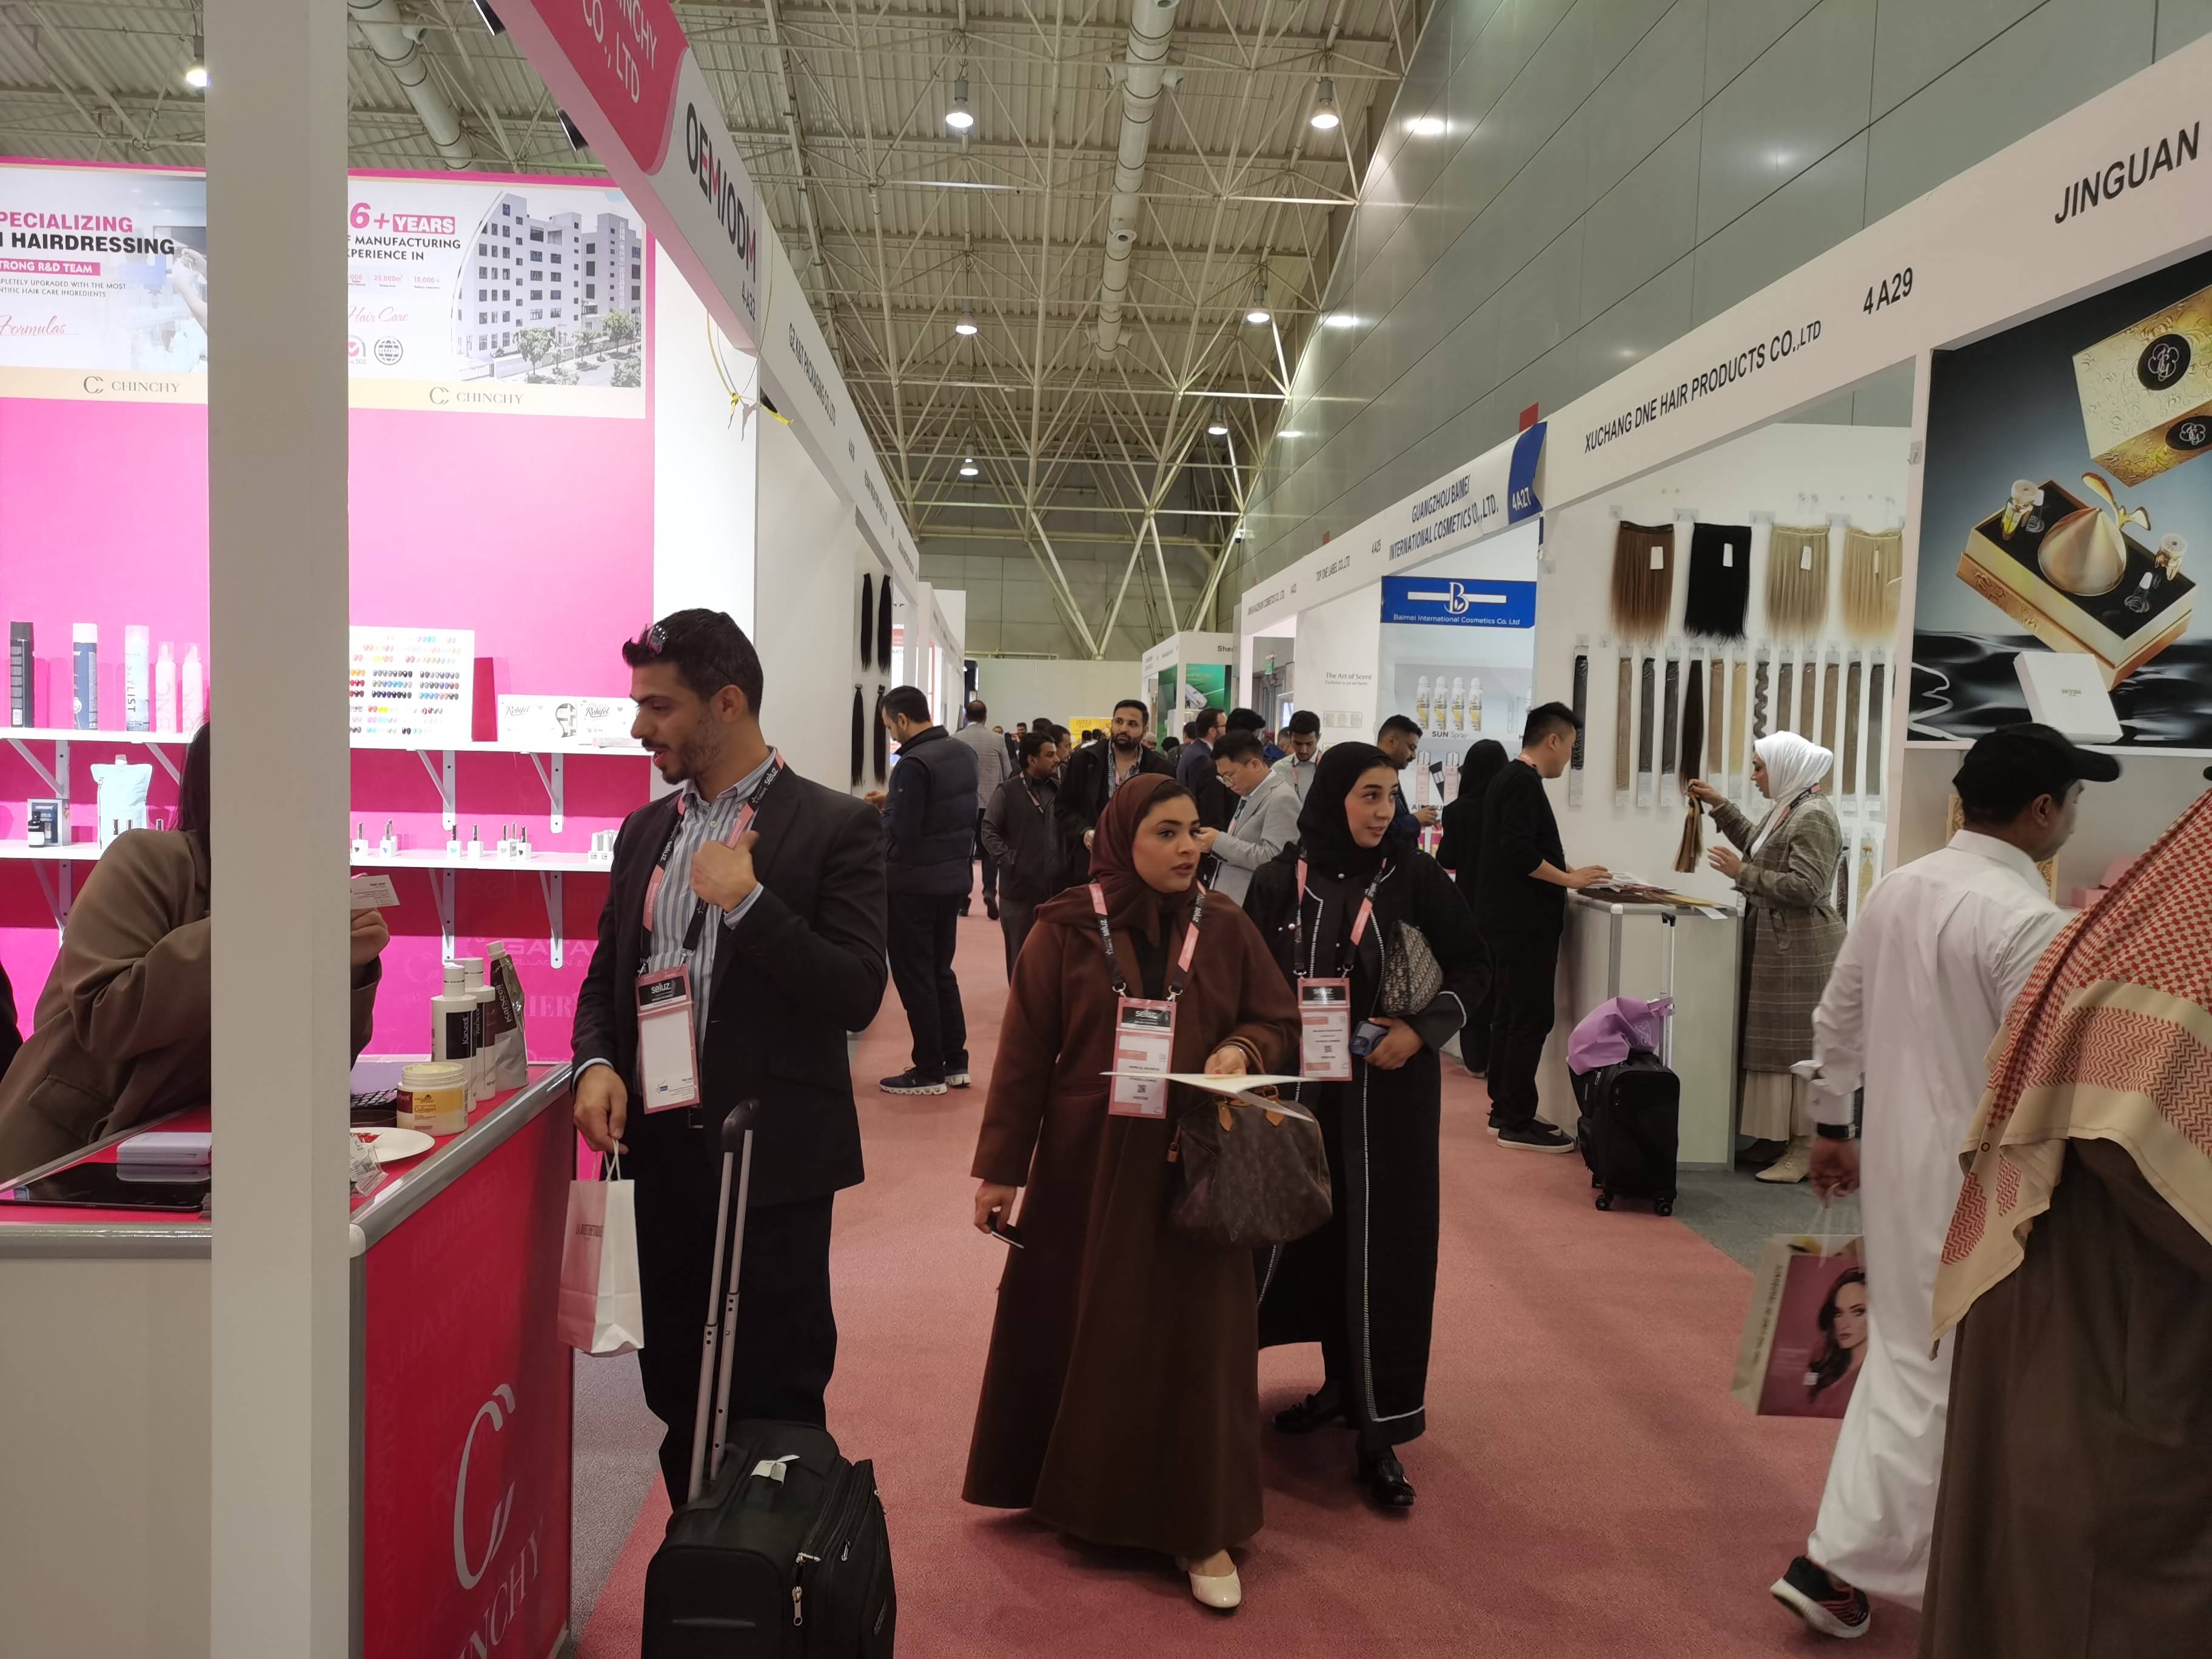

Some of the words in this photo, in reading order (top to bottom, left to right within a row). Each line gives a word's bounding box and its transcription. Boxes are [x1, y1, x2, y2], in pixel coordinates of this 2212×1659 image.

[618, 0, 657, 69] NCHY
[617, 32, 639, 103] LTD
[2054, 122, 2200, 224] JINGUAN
[394, 216, 454, 233] YEARS
[12, 232, 175, 255] HAIRDRESSING
[355, 235, 461, 249] MANUFACTURING
[412, 252, 424, 261] IN
[38, 262, 61, 272] R&D
[62, 263, 93, 273] TEAM
[378, 306, 409, 322] Care
[112, 381, 180, 393] CHINCHY
[457, 391, 524, 404] CHINCHY
[1584, 412, 1632, 454] XUCHANG
[1635, 398, 1658, 429] DNE
[1660, 383, 1688, 417] HAIR
[1692, 343, 1766, 401] PRODUCTS
[1412, 488, 1450, 523] GUANGZHOU
[1512, 486, 1532, 511] 4A27
[1389, 525, 1432, 561] INTERNATIONAL
[1433, 508, 1472, 541] COSMETICS
[1418, 614, 1460, 623] International
[1461, 617, 1495, 625] Cosmetics
[1450, 731, 1468, 740] Spray
